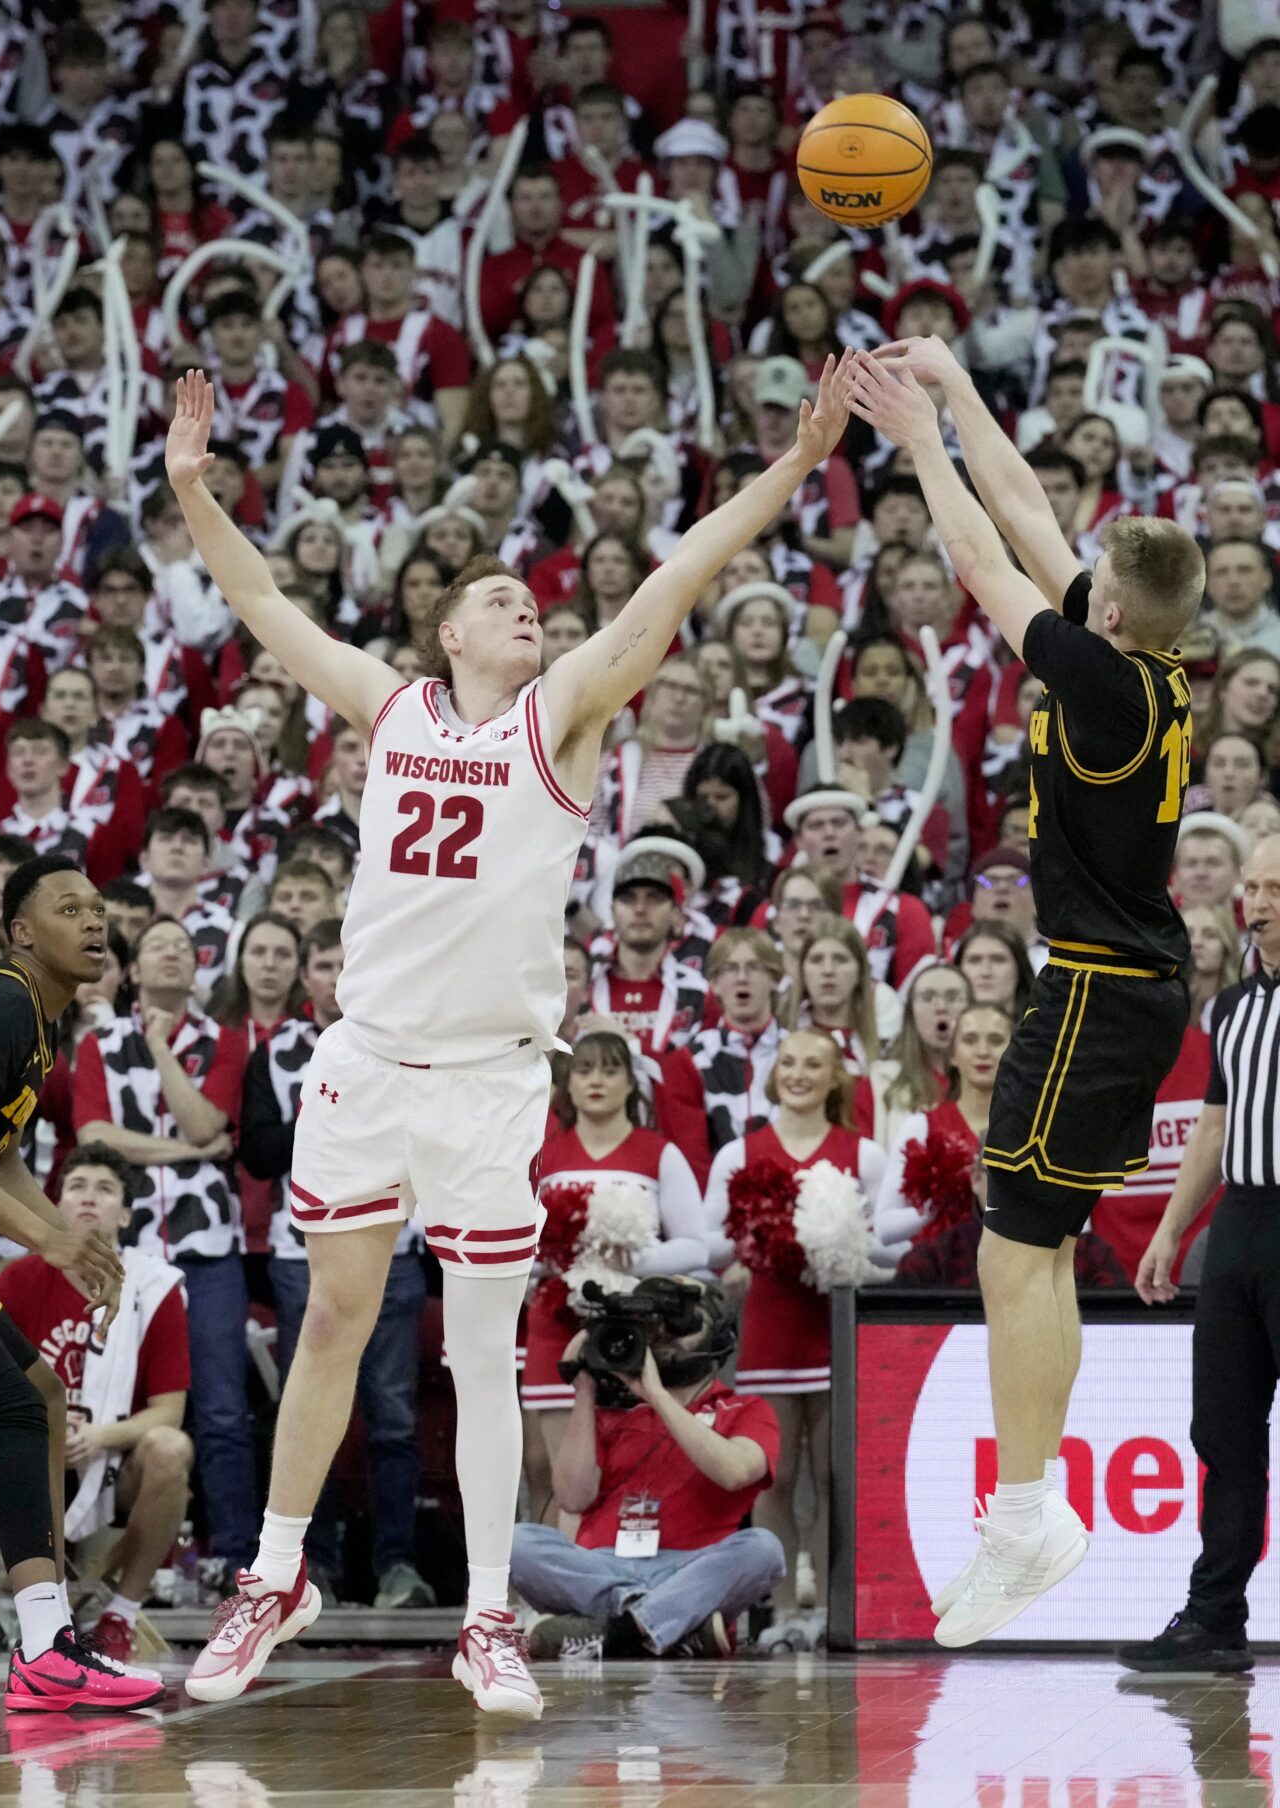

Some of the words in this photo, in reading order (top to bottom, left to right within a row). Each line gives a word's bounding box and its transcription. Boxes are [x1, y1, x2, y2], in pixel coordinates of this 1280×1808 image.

[821, 188, 882, 208] NCAA
[386, 751, 510, 786] WISCONSIN
[390, 791, 484, 879] 22
[1149, 1117, 1198, 1148] GE
